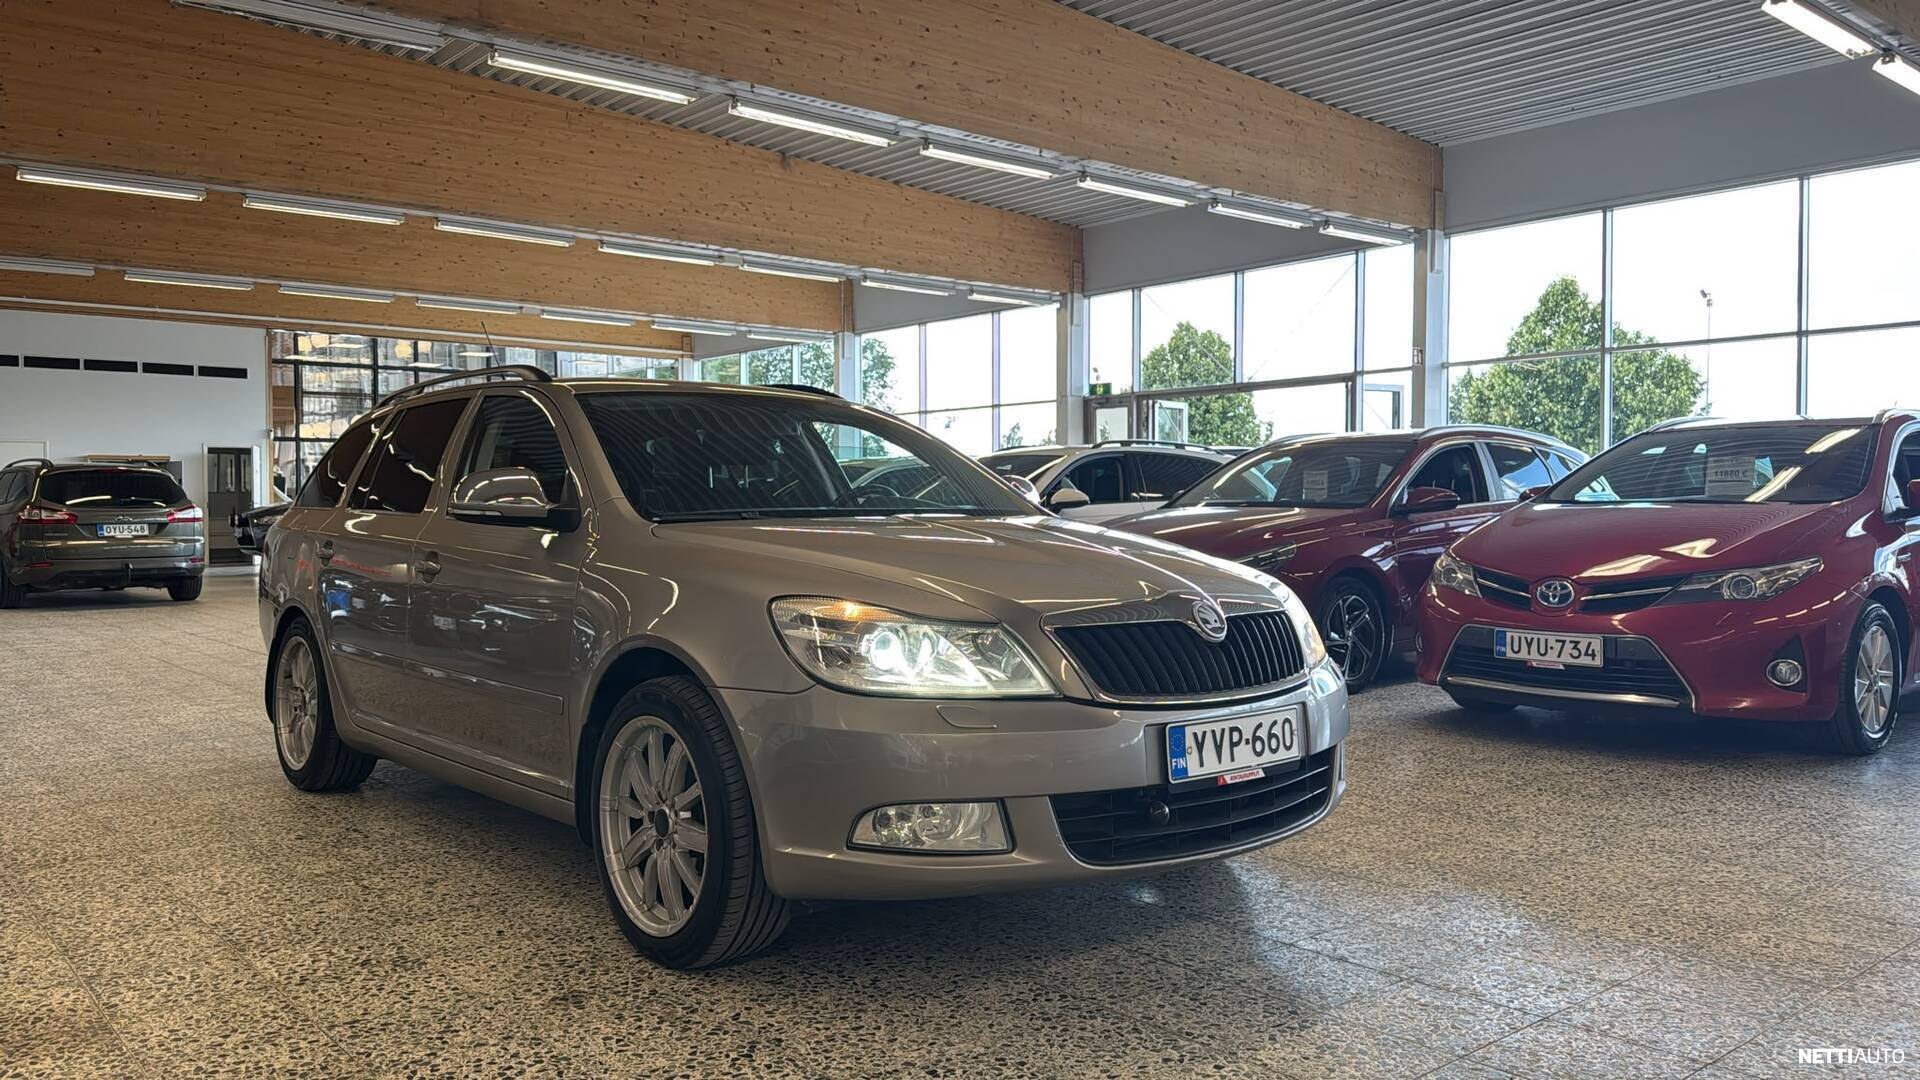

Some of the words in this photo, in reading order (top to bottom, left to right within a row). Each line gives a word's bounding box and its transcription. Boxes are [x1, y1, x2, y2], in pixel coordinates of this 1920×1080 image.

[1510, 635, 1597, 661] UYU-734
[1171, 757, 1187, 770] FIN
[1192, 717, 1294, 768] YVP-660
